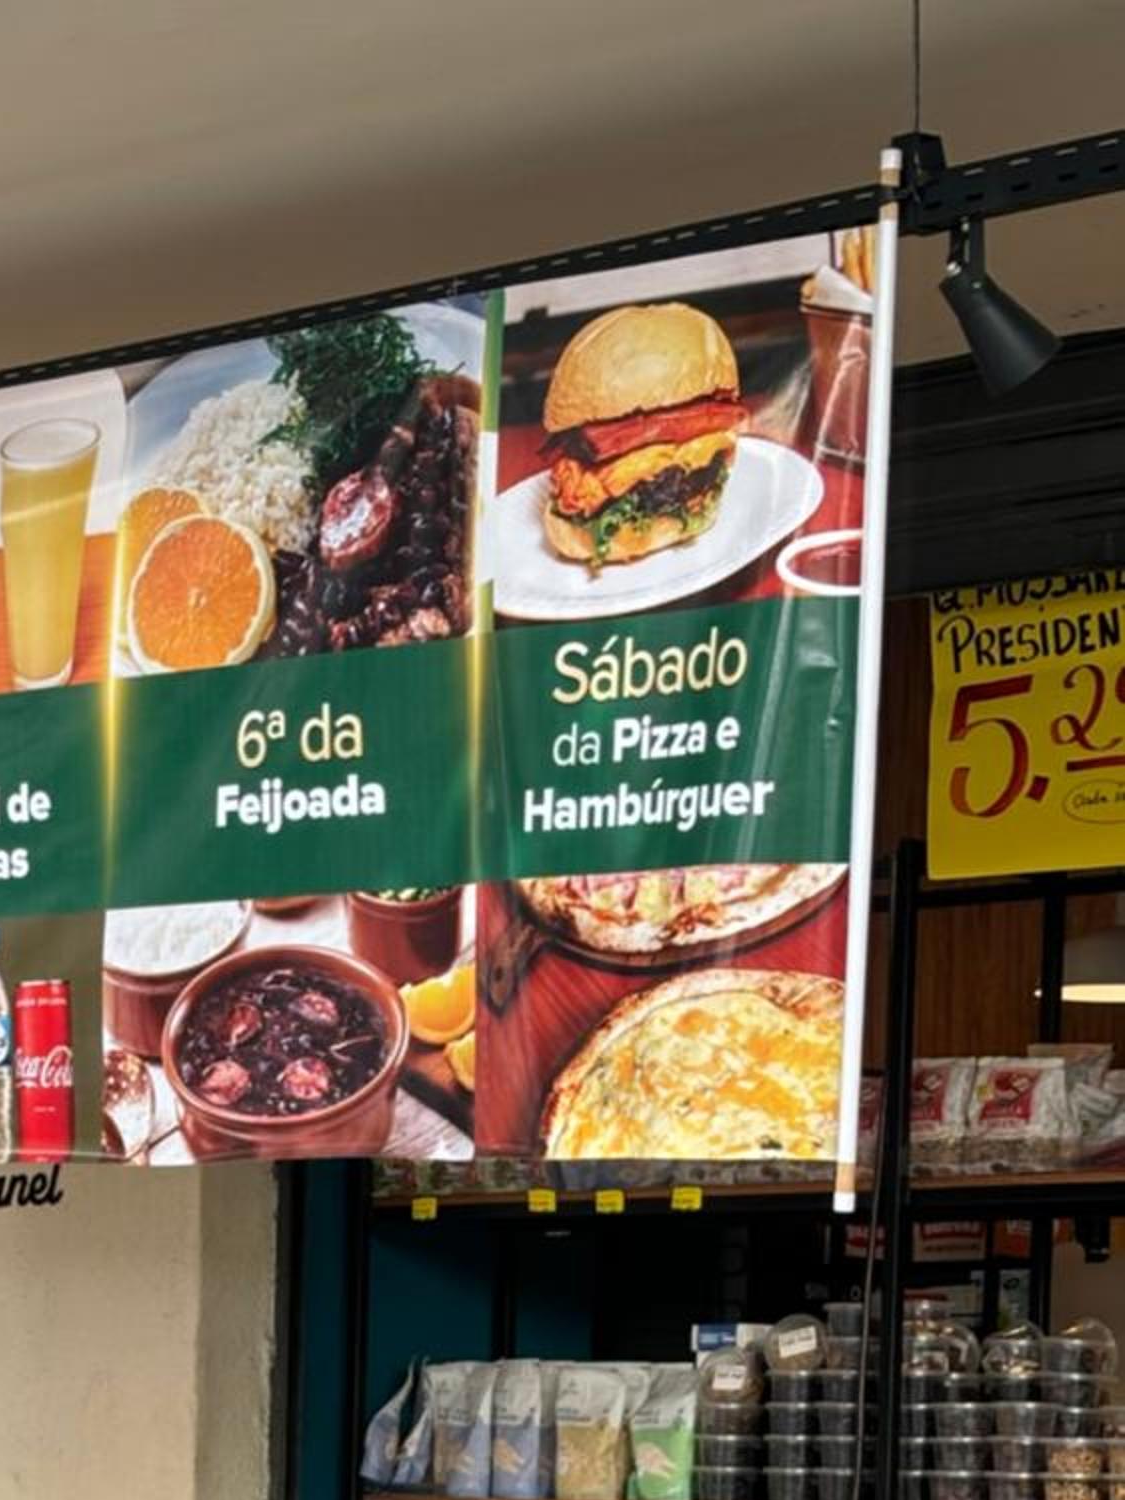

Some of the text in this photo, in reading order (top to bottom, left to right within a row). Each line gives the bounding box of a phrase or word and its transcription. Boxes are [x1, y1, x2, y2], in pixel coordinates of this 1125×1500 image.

[553, 626, 748, 704] Sábado
[937, 604, 1125, 673] PRESIDEN
[237, 703, 364, 768] 6ª da
[553, 713, 740, 766] da Pizza e
[8, 783, 51, 823] de
[216, 772, 386, 833] Feijoada
[524, 775, 774, 833] Hambúrguer
